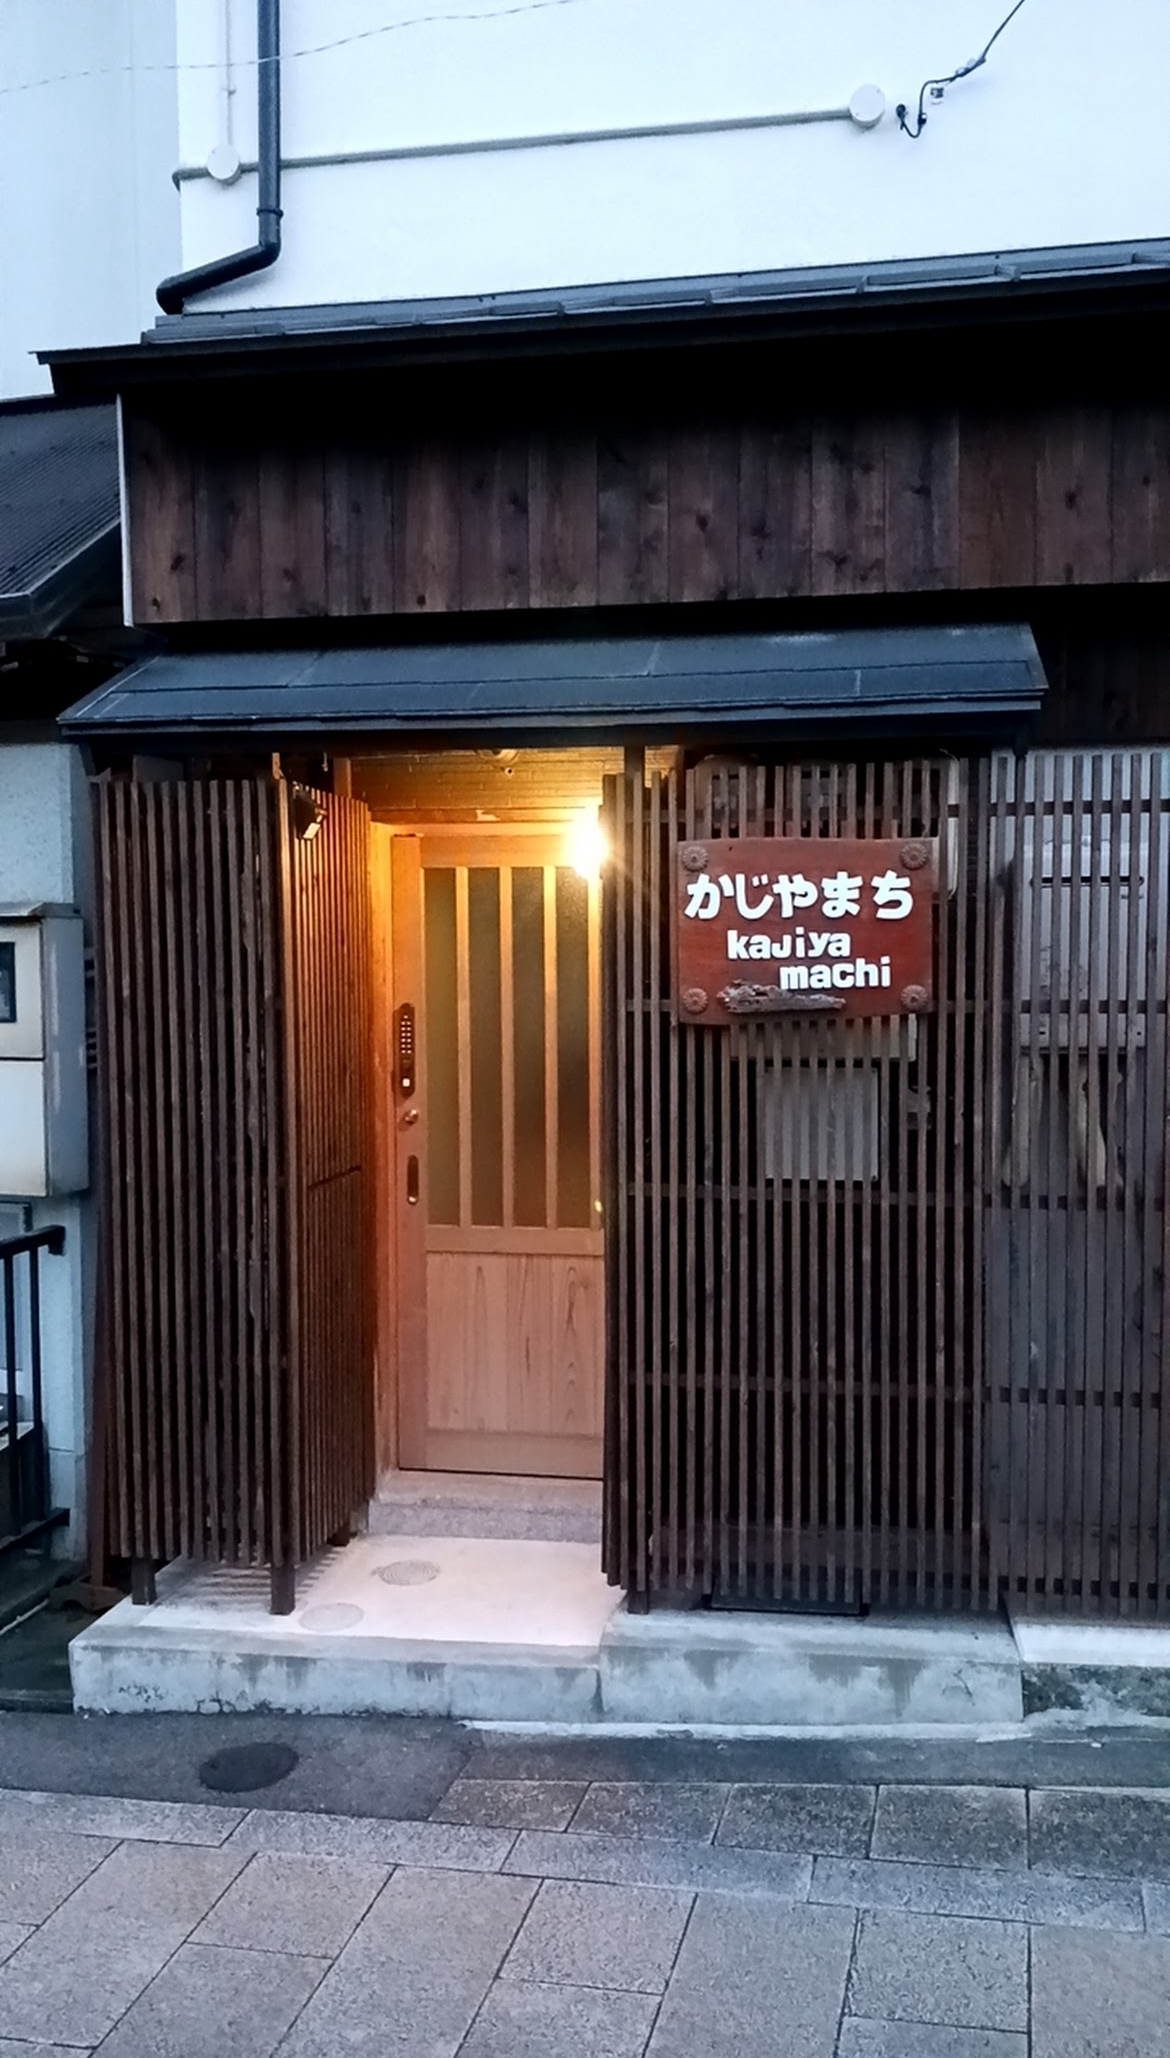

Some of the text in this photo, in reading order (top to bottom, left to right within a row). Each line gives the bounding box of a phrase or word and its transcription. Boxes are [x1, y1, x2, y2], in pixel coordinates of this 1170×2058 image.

[685, 870, 914, 919] かじやまち
[779, 956, 891, 989] machi
